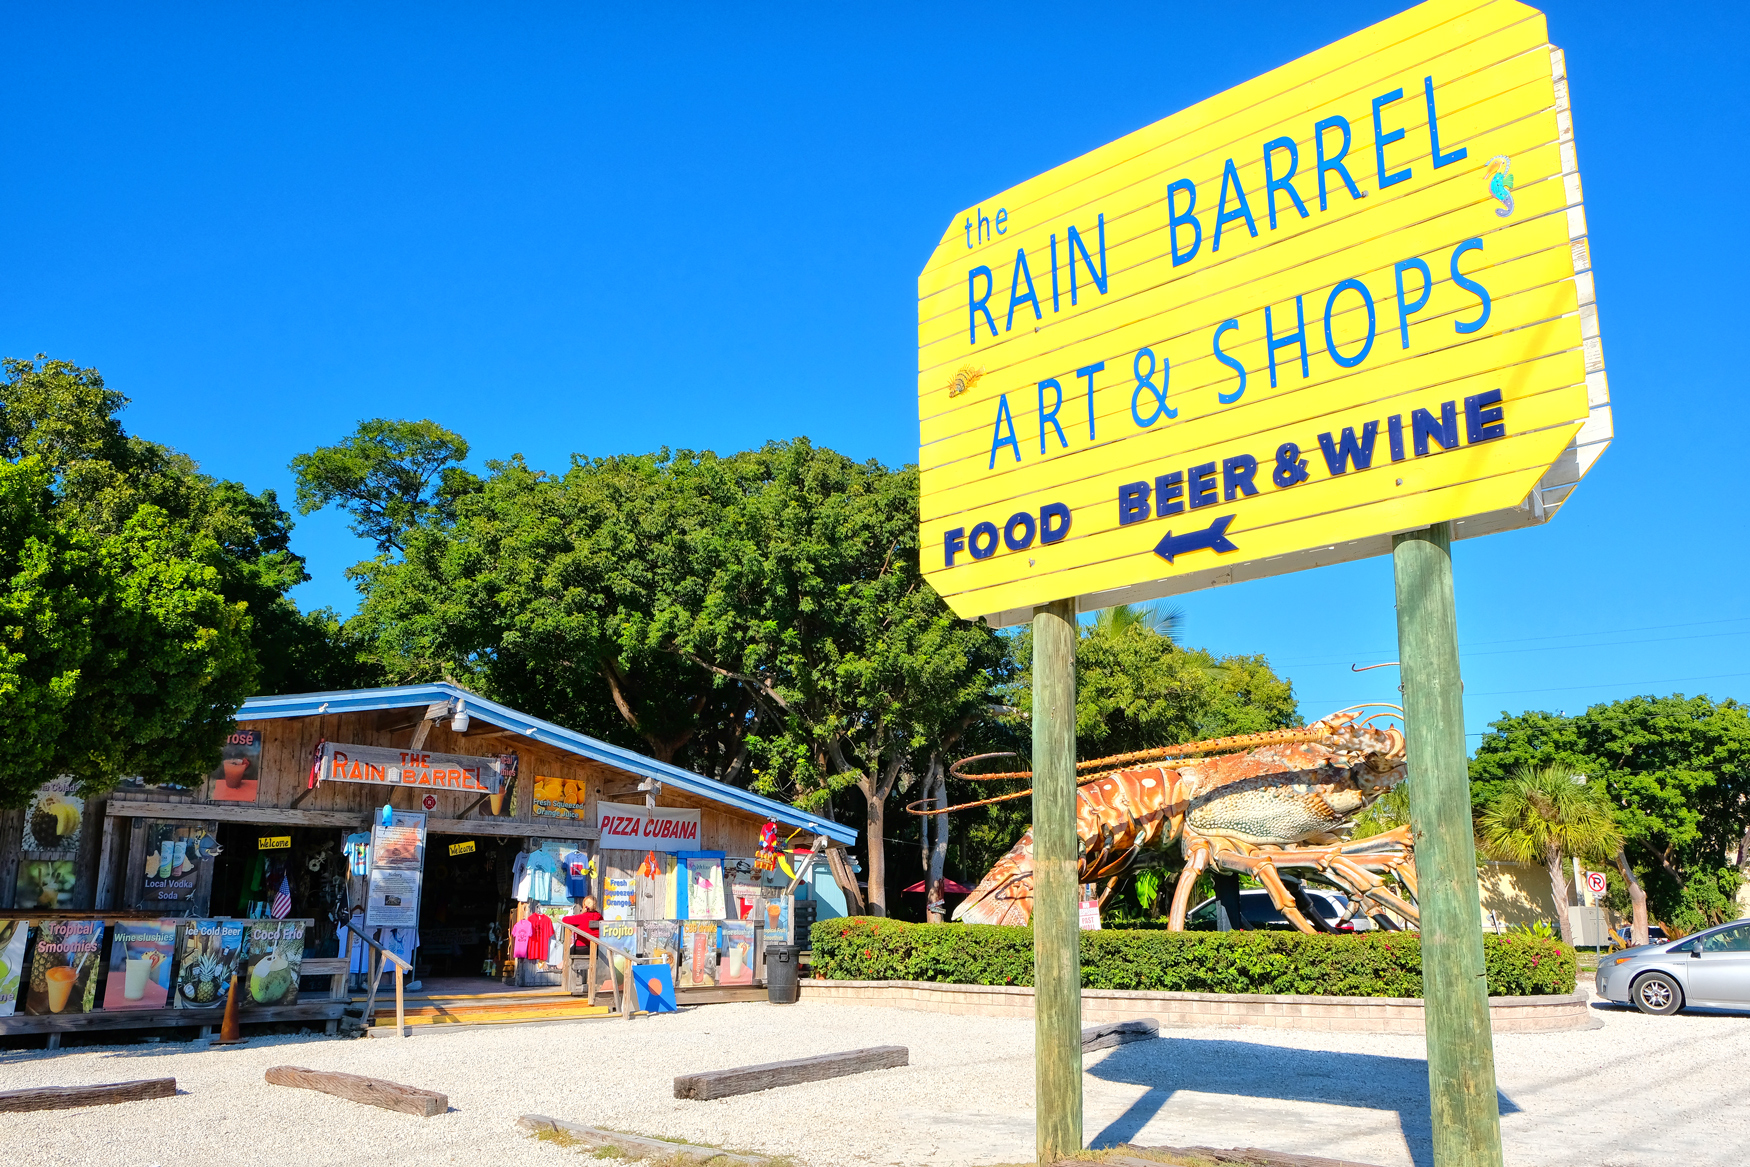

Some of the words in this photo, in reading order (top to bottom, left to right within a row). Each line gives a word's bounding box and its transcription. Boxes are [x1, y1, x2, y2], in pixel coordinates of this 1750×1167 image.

[968, 213, 1108, 345] RAIN
[1167, 75, 1468, 269] BARREL
[965, 207, 1008, 249] the
[989, 361, 1106, 470] ART
[1131, 347, 1179, 428] &
[1212, 237, 1492, 405] SHOPS
[944, 502, 1073, 568] FOOD
[1118, 453, 1259, 526] BEER
[1272, 442, 1310, 488] &
[1317, 388, 1506, 476] WINE
[226, 732, 253, 746] rosé
[400, 752, 431, 768] THE
[332, 751, 386, 781] RAIN
[402, 767, 489, 791] BARREL
[533, 799, 551, 807] Fresh
[552, 800, 584, 810] Squeezed
[537, 808, 560, 818] Orange
[561, 811, 579, 819] Juice
[600, 815, 640, 837] PIZZA
[643, 819, 698, 840] CUBANA
[259, 838, 289, 849] Welcome
[450, 842, 474, 856] Welcome
[145, 879, 166, 888] Local
[168, 879, 193, 888] Vodka
[610, 879, 628, 887] Fresh
[158, 891, 178, 900] Soda
[605, 889, 635, 897] Squeezed
[606, 899, 632, 907] Oranges
[49, 923, 94, 937] Tropical
[185, 927, 199, 936] Ice
[200, 927, 220, 936] Cold
[222, 927, 242, 936] Beer
[603, 925, 634, 940] Frojito
[684, 923, 697, 933] CBD
[699, 923, 718, 933] drinks
[114, 933, 136, 942] Wine
[137, 932, 174, 942] slushies
[254, 929, 280, 940] Coco
[38, 940, 98, 953] Smoothies
